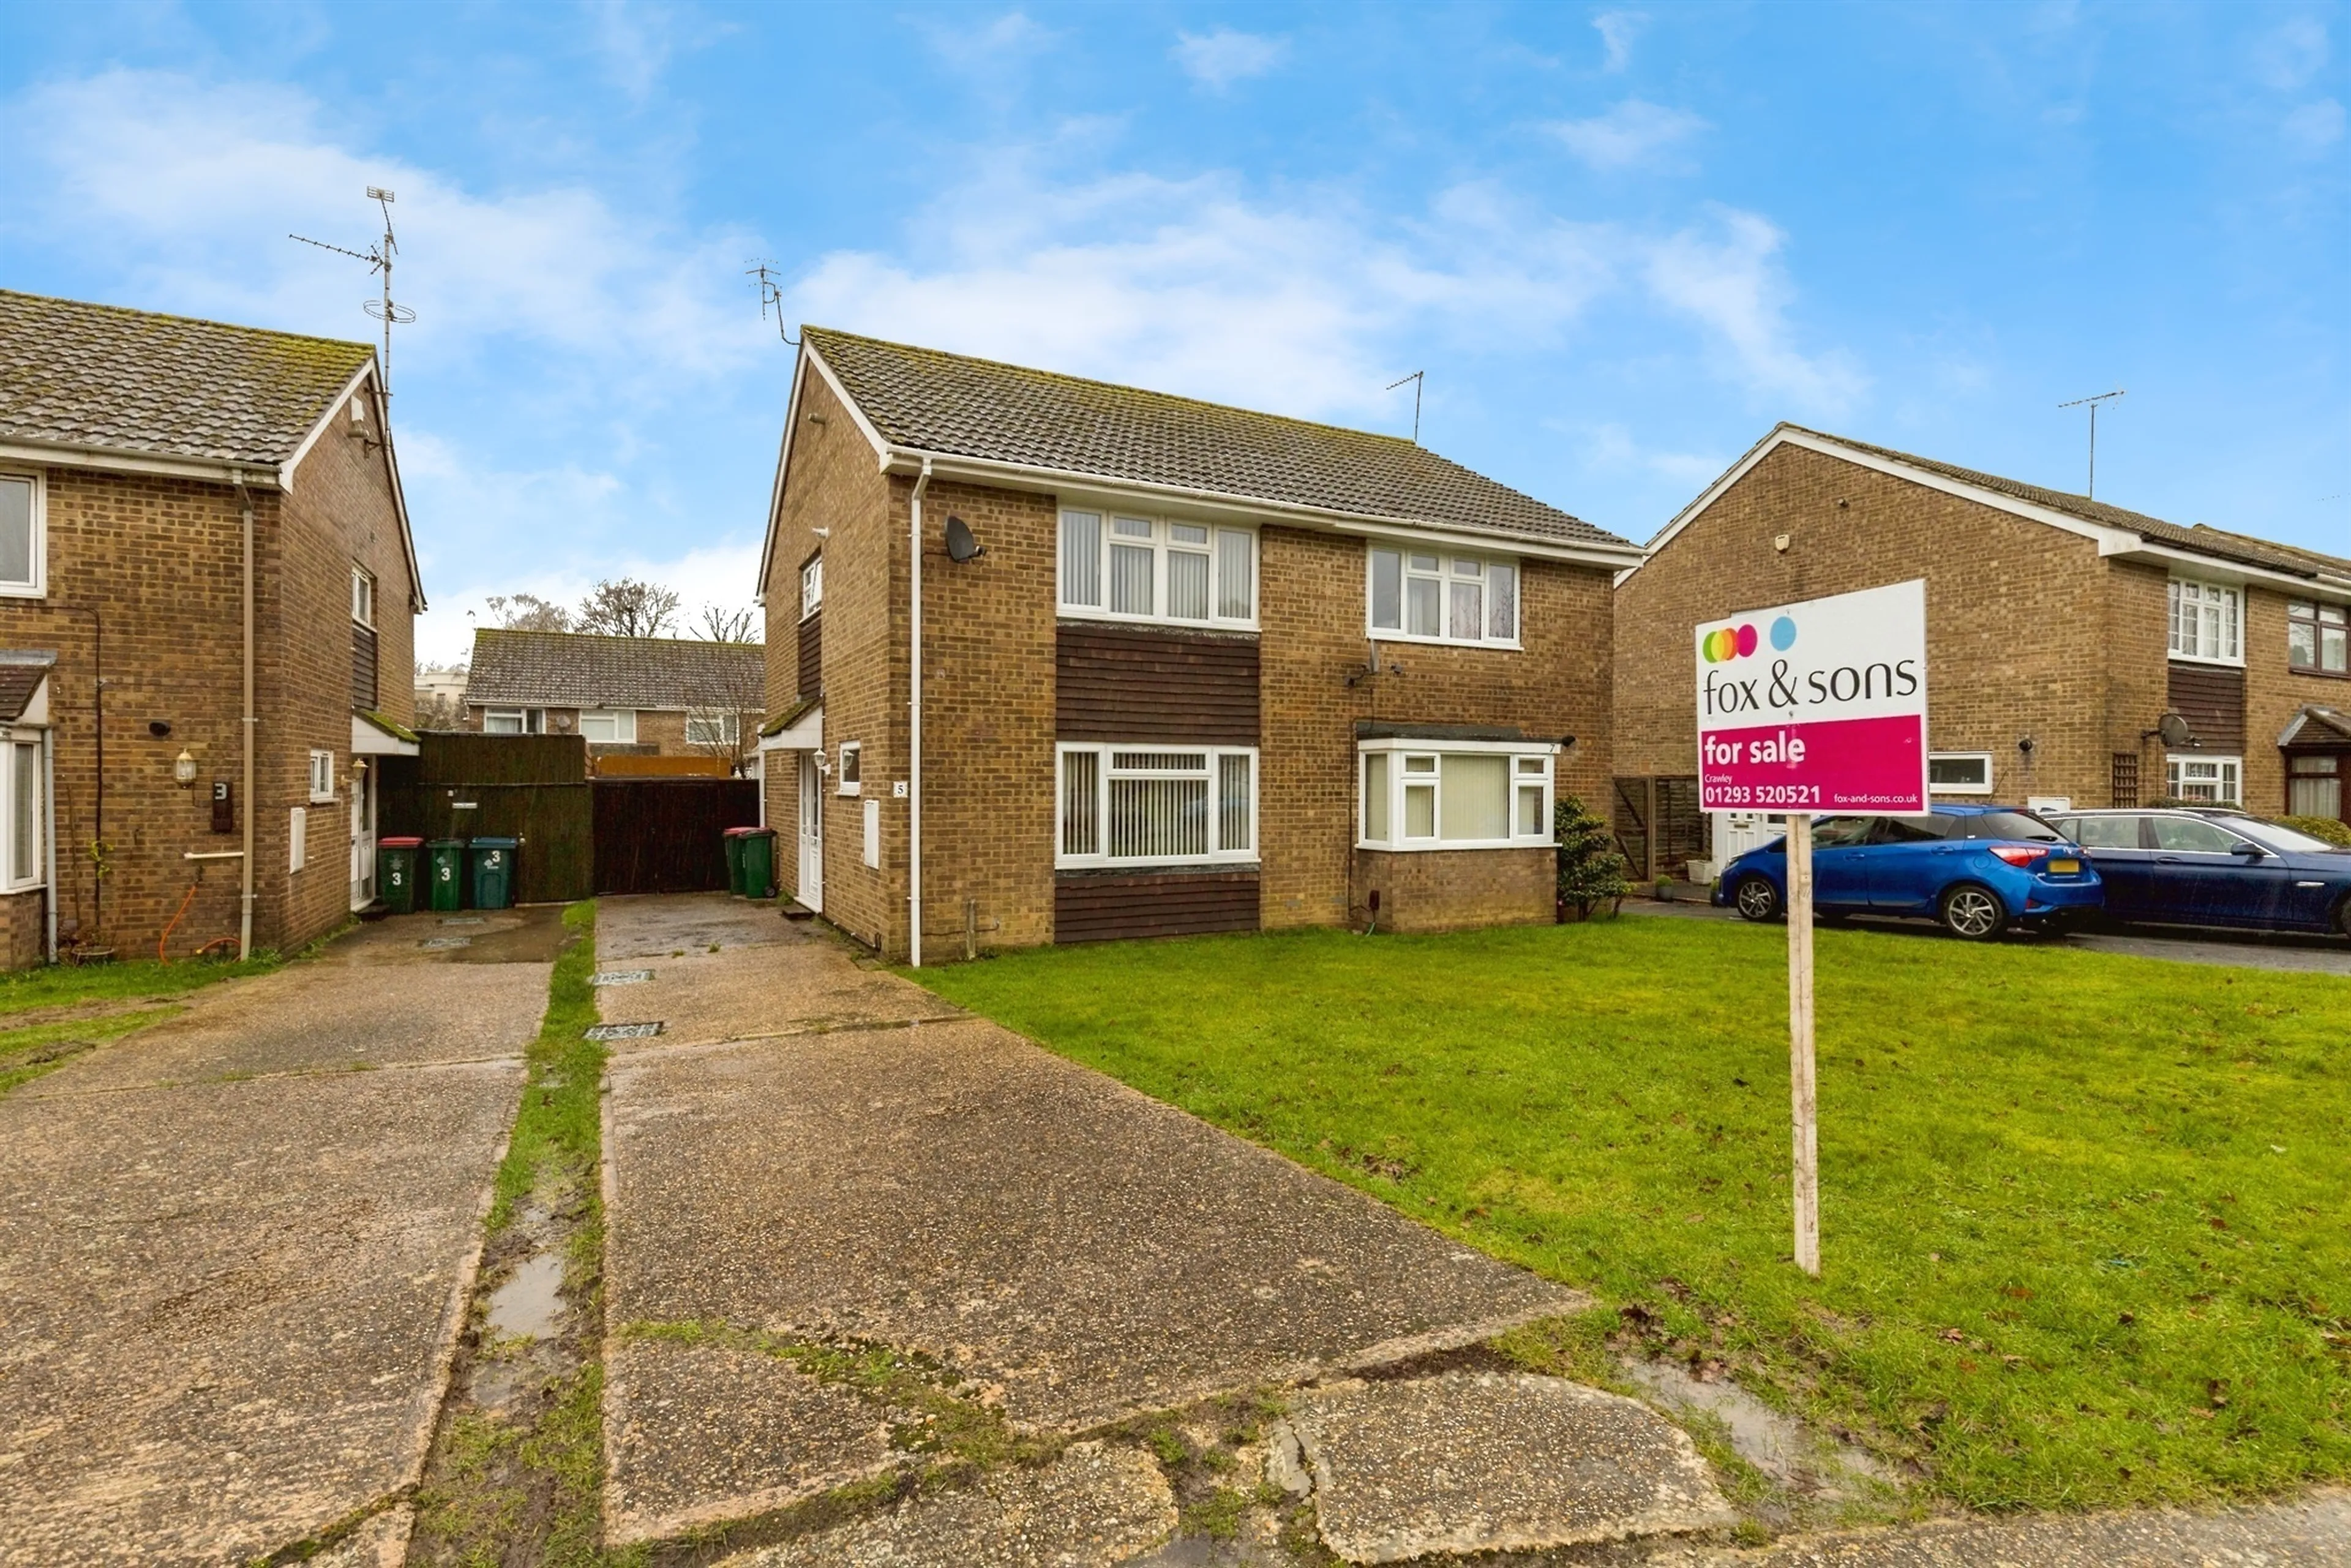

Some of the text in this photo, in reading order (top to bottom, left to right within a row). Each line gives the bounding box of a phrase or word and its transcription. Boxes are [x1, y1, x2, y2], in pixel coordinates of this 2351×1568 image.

[1703, 659, 1918, 715] fox & sons
[1704, 730, 1805, 765] for sale
[1704, 773, 1732, 784] Crawley
[214, 783, 227, 800] 3
[898, 785, 904, 794] 5
[1705, 785, 1820, 803] 01293 520521
[1834, 793, 1918, 804] fox-and-sons.co.uk
[492, 850, 501, 863] 3
[392, 872, 402, 885] 3
[441, 867, 451, 881] 3
